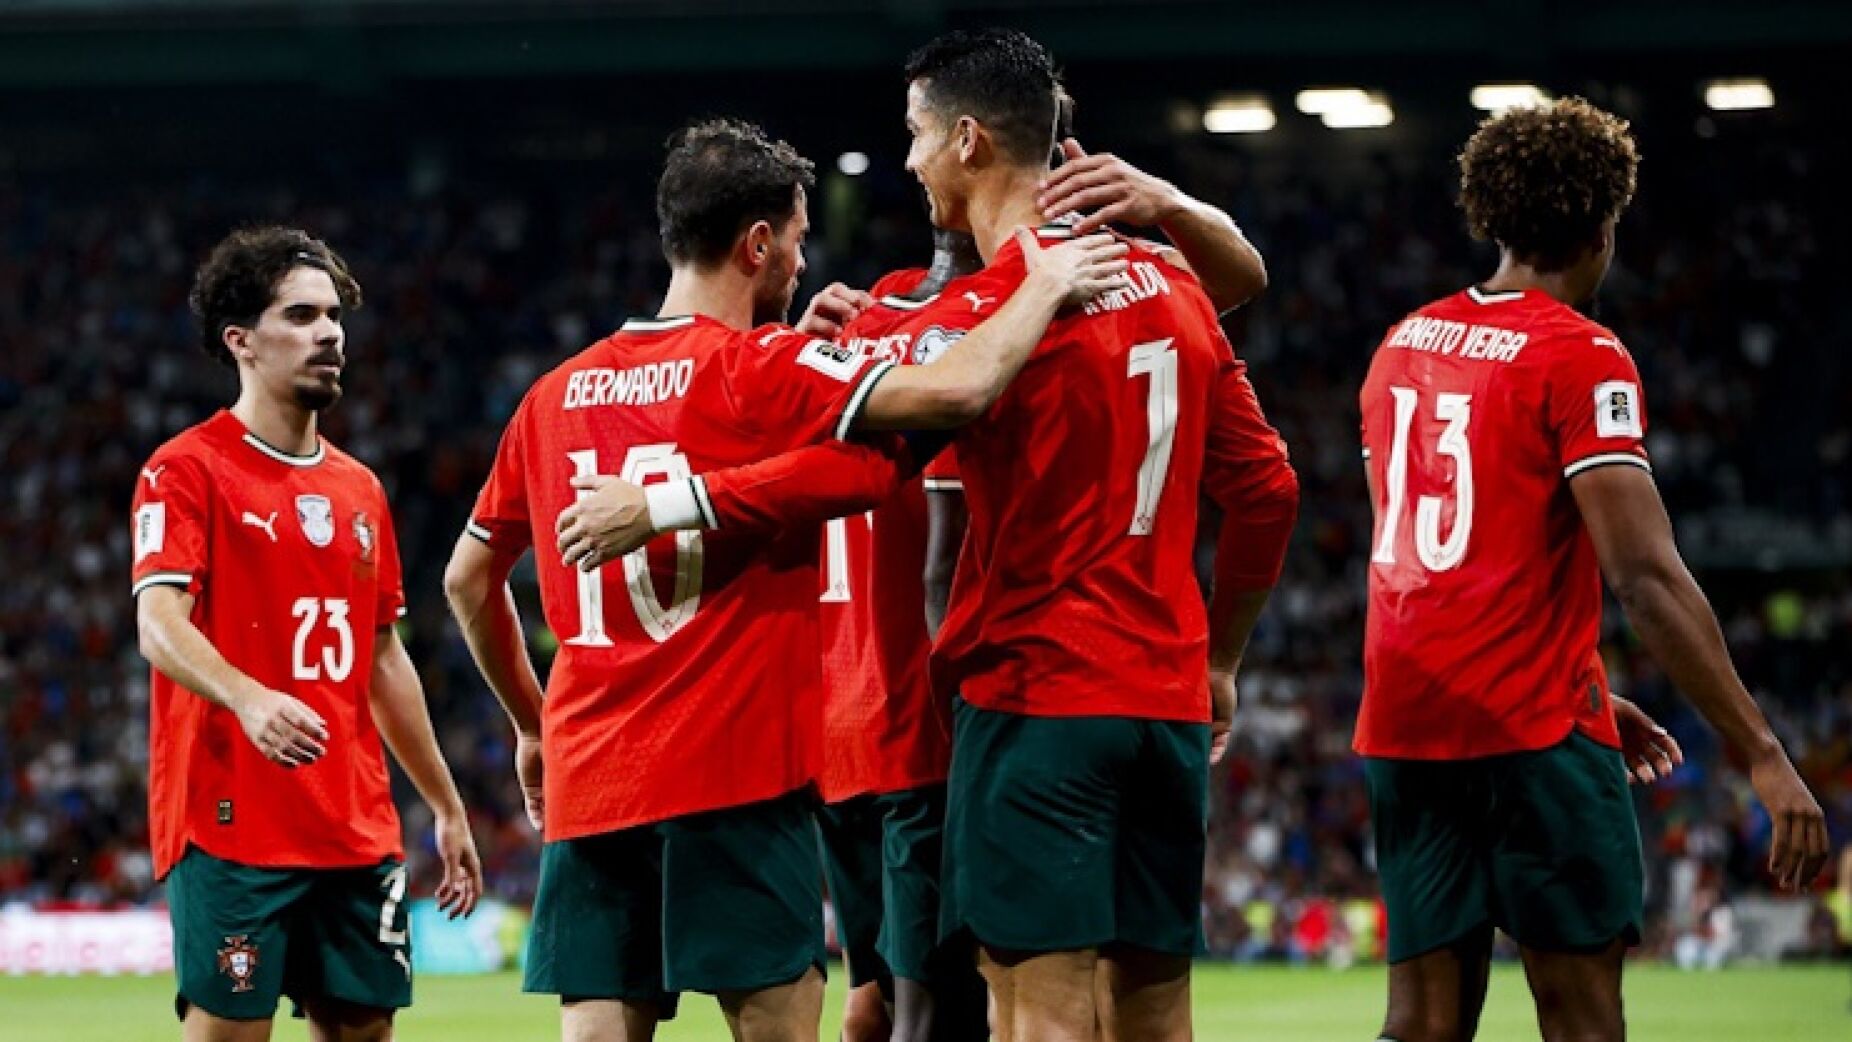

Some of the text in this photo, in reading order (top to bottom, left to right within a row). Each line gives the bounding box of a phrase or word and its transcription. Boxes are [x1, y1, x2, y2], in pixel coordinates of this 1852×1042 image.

[562, 358, 694, 409] BERNARDO
[1459, 324, 1529, 363] VEIGA
[1127, 337, 1178, 536] 7
[1371, 386, 1473, 572] 13
[564, 442, 703, 647] 10
[292, 596, 355, 682] 23
